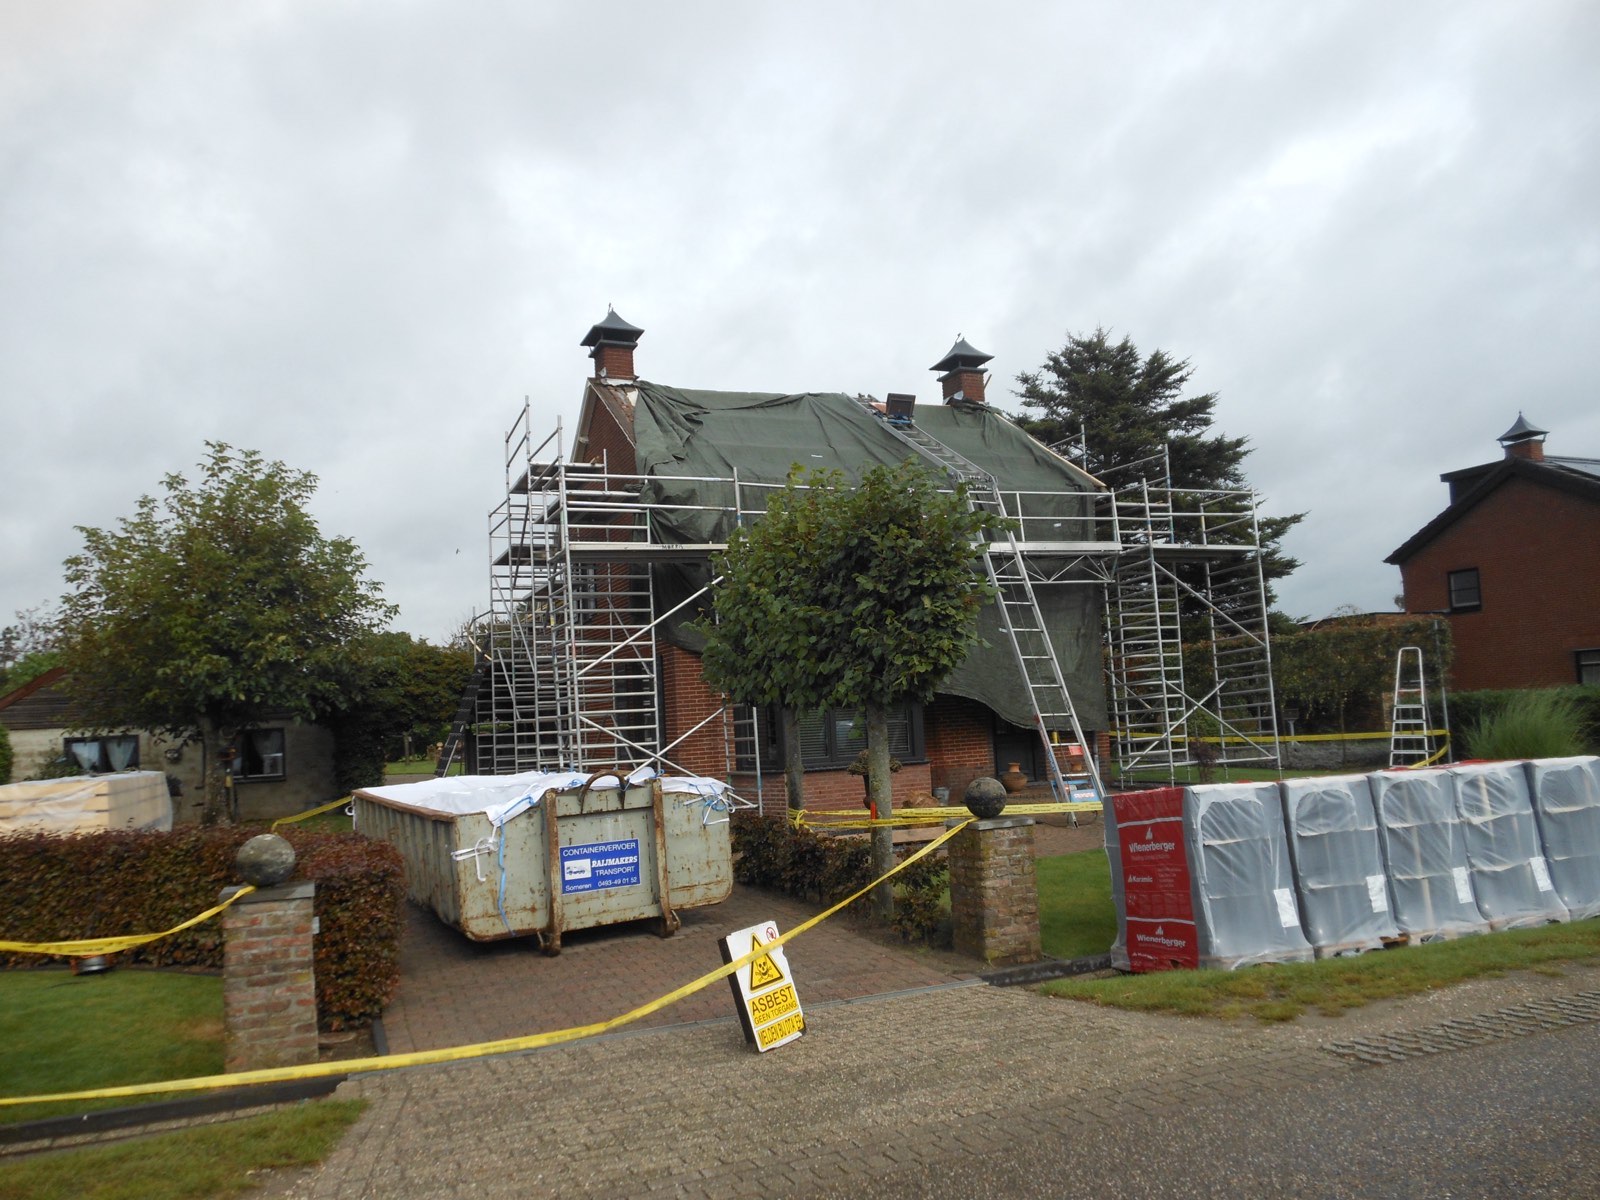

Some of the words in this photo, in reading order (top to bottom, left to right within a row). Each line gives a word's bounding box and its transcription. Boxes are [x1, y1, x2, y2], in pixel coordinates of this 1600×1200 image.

[563, 842, 636, 857] CONTAINERVERVOER
[1129, 841, 1175, 853] Wienerberger
[592, 856, 638, 868] RAIJMAKERS
[595, 866, 635, 877] TRANSPORT
[565, 883, 592, 892] Someren
[1136, 934, 1186, 947] Wienerberger
[752, 986, 793, 1015] ASBEST
[754, 1013, 770, 1025] GEEN
[771, 1000, 797, 1018] TOEGANG
